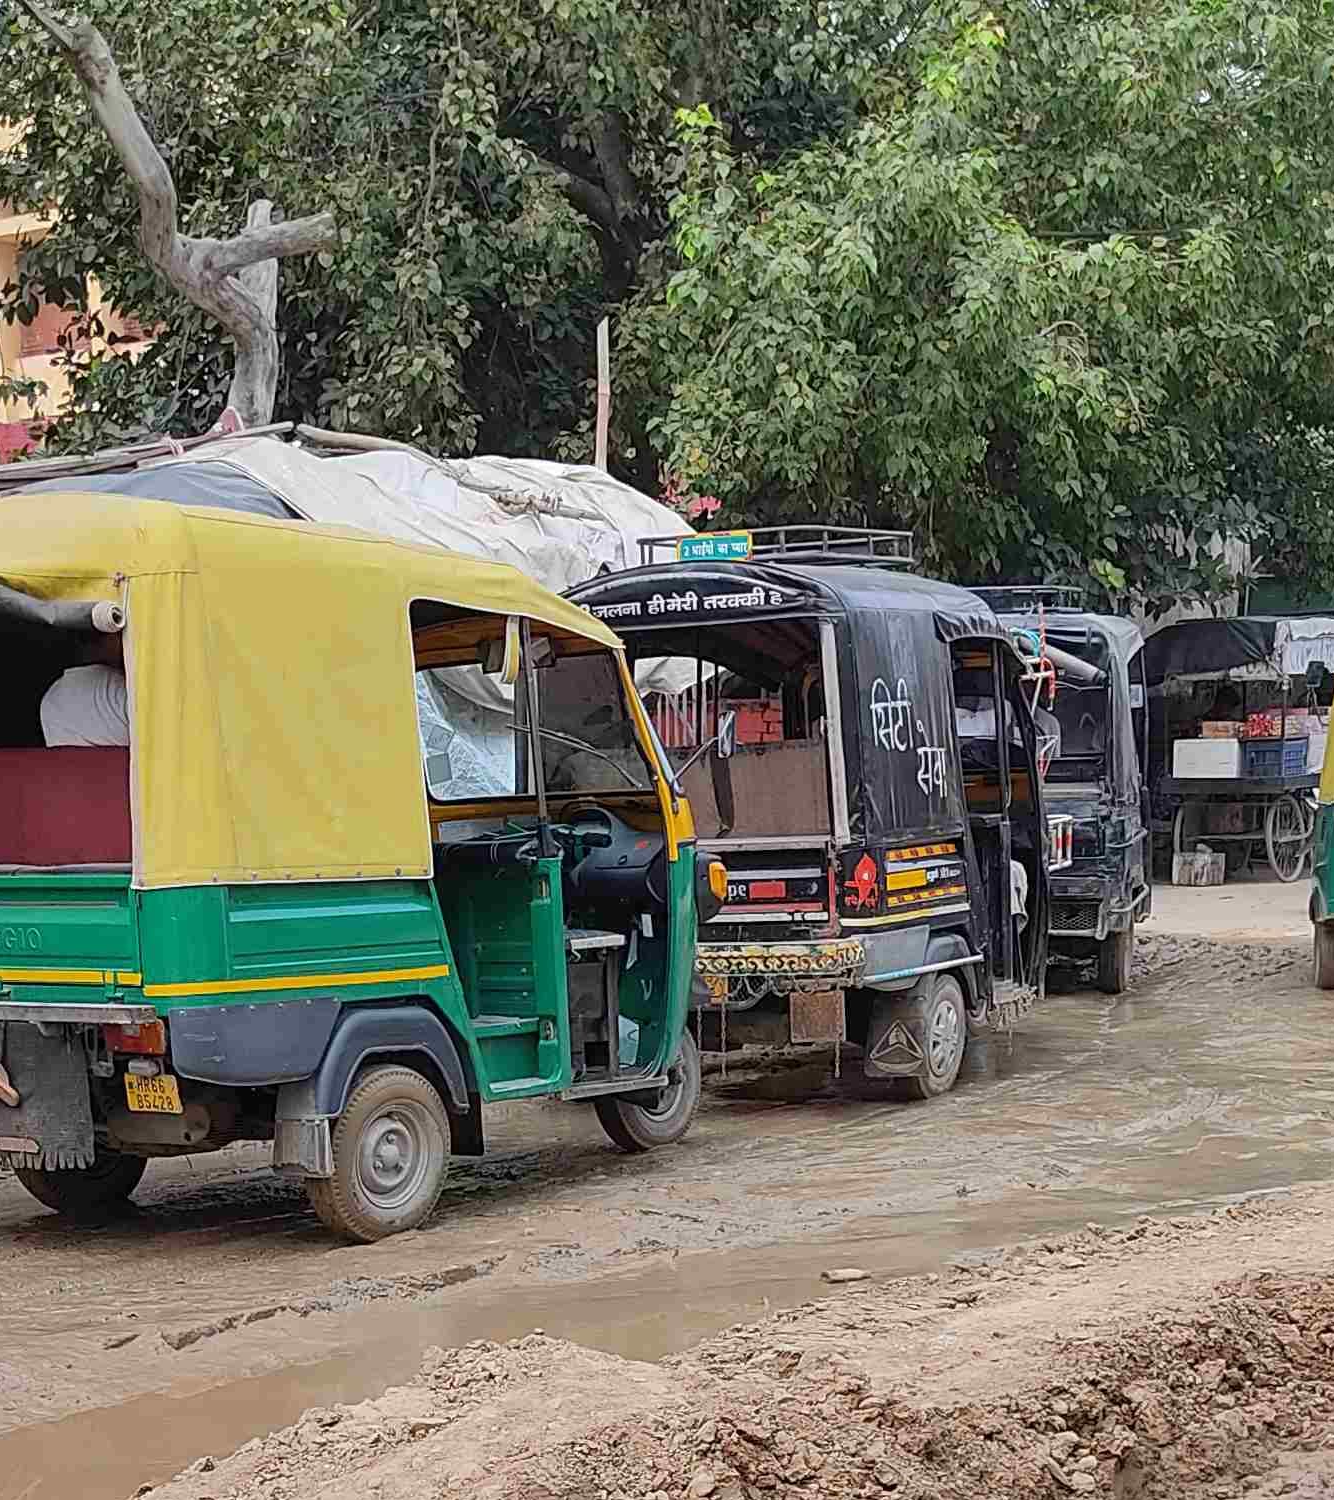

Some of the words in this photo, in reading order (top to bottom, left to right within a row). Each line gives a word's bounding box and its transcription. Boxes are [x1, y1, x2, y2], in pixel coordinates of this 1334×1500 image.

[591, 601, 642, 619] जलना
[646, 593, 665, 615] ही
[666, 590, 698, 612] मेरी
[702, 586, 766, 609] तरक्की
[869, 677, 913, 752] सिटी
[915, 719, 948, 798] सेवा
[726, 880, 748, 898] pe
